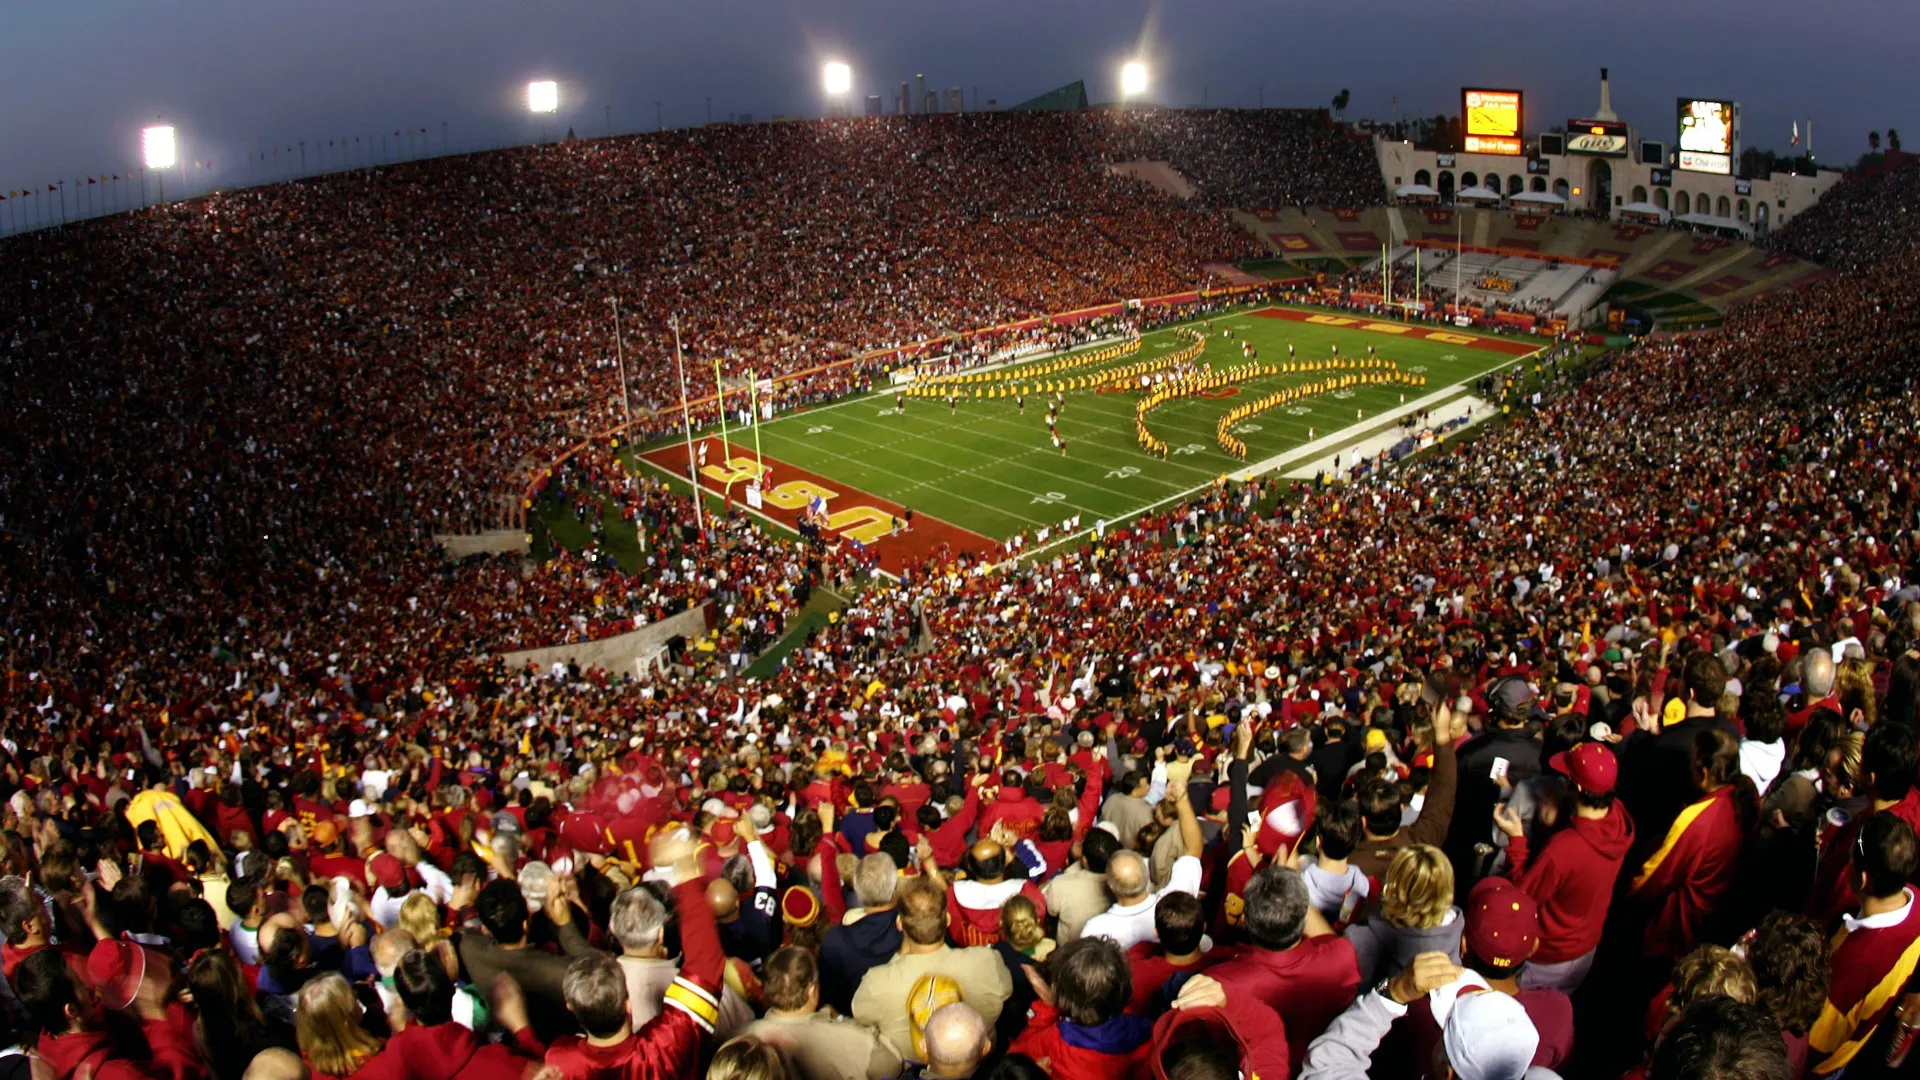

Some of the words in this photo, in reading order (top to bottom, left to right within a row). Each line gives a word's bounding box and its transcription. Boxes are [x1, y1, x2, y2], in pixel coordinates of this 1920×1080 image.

[1695, 157, 1728, 169] Chevron
[1305, 314, 1479, 345] USC
[699, 457, 908, 545] USC
[1493, 957, 1511, 967] USC
